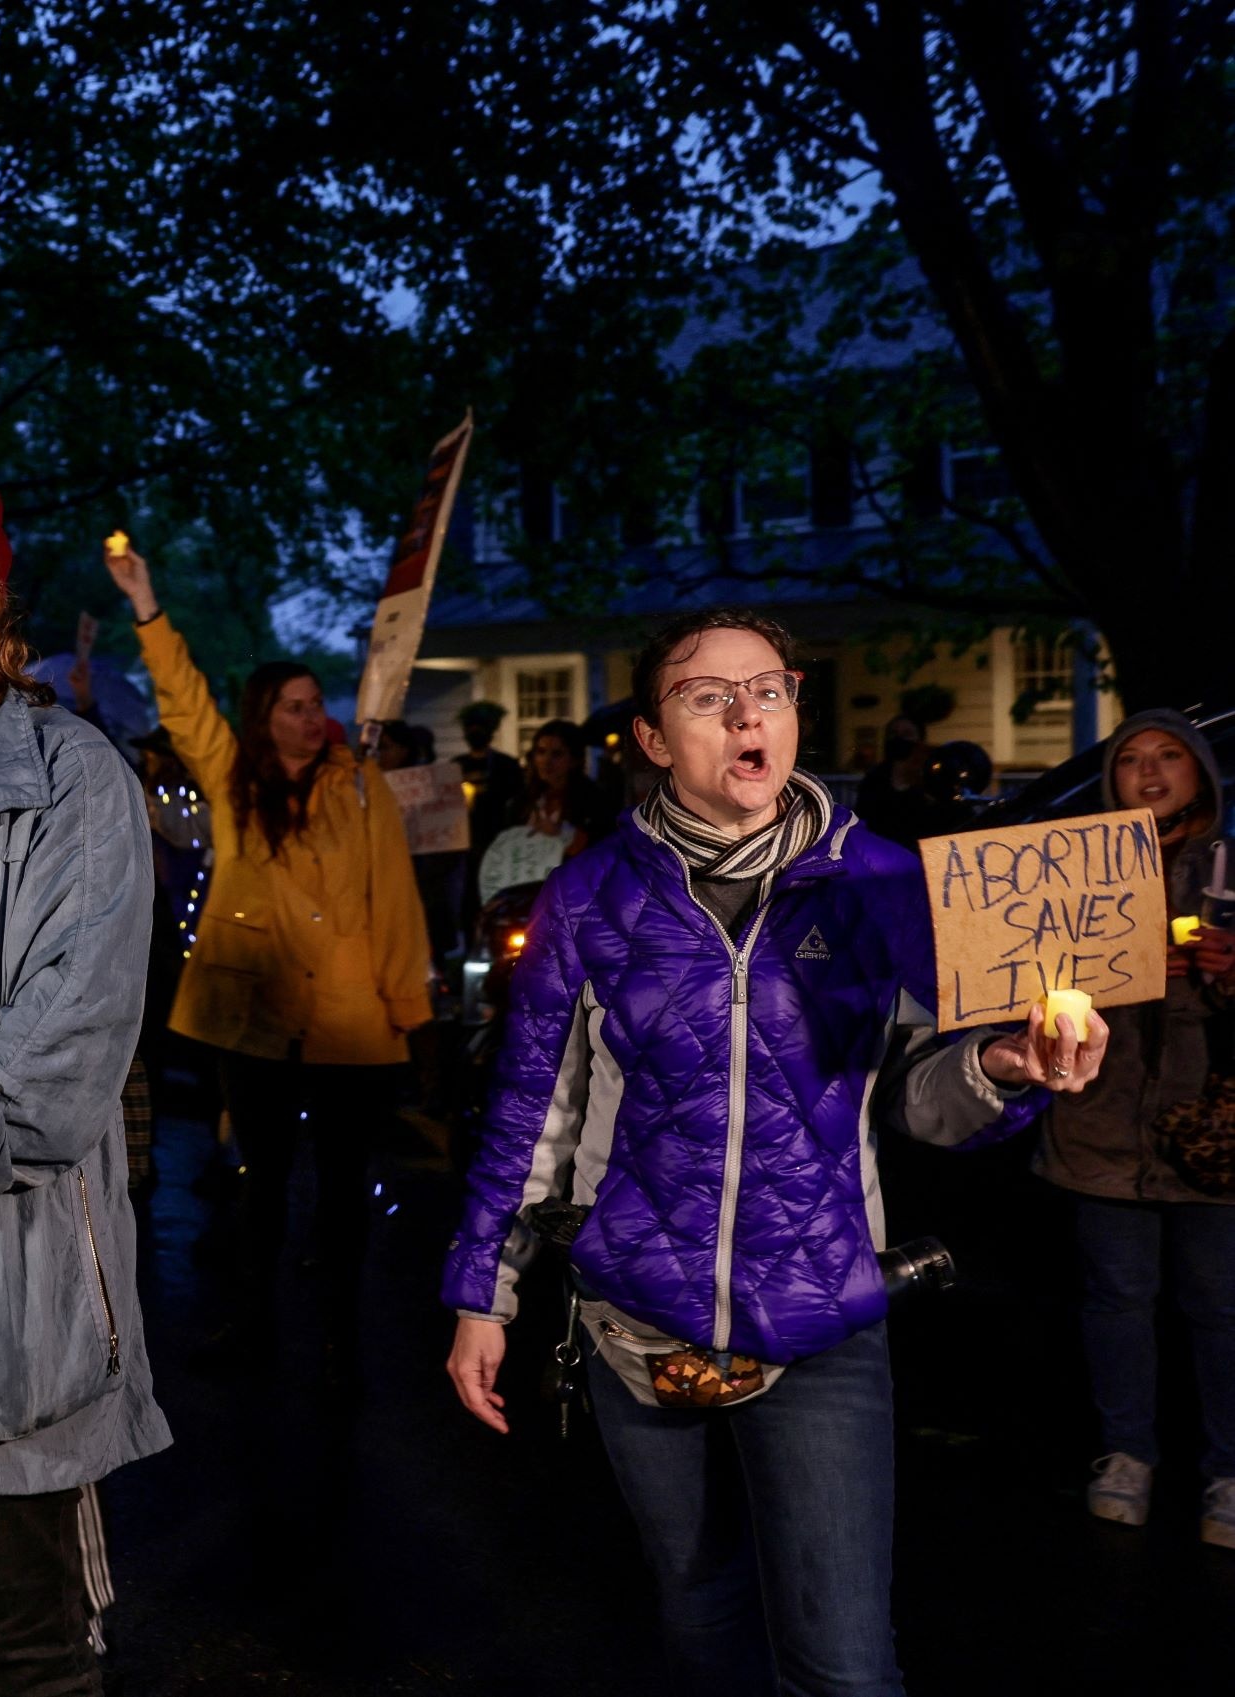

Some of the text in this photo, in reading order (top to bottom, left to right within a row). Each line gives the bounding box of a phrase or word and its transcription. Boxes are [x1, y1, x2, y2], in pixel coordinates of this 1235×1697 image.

[943, 813, 1159, 912] ABORTION
[795, 951, 832, 961] GERRY
[1000, 893, 1136, 957] SAVES
[955, 951, 1133, 1021] LIVES
